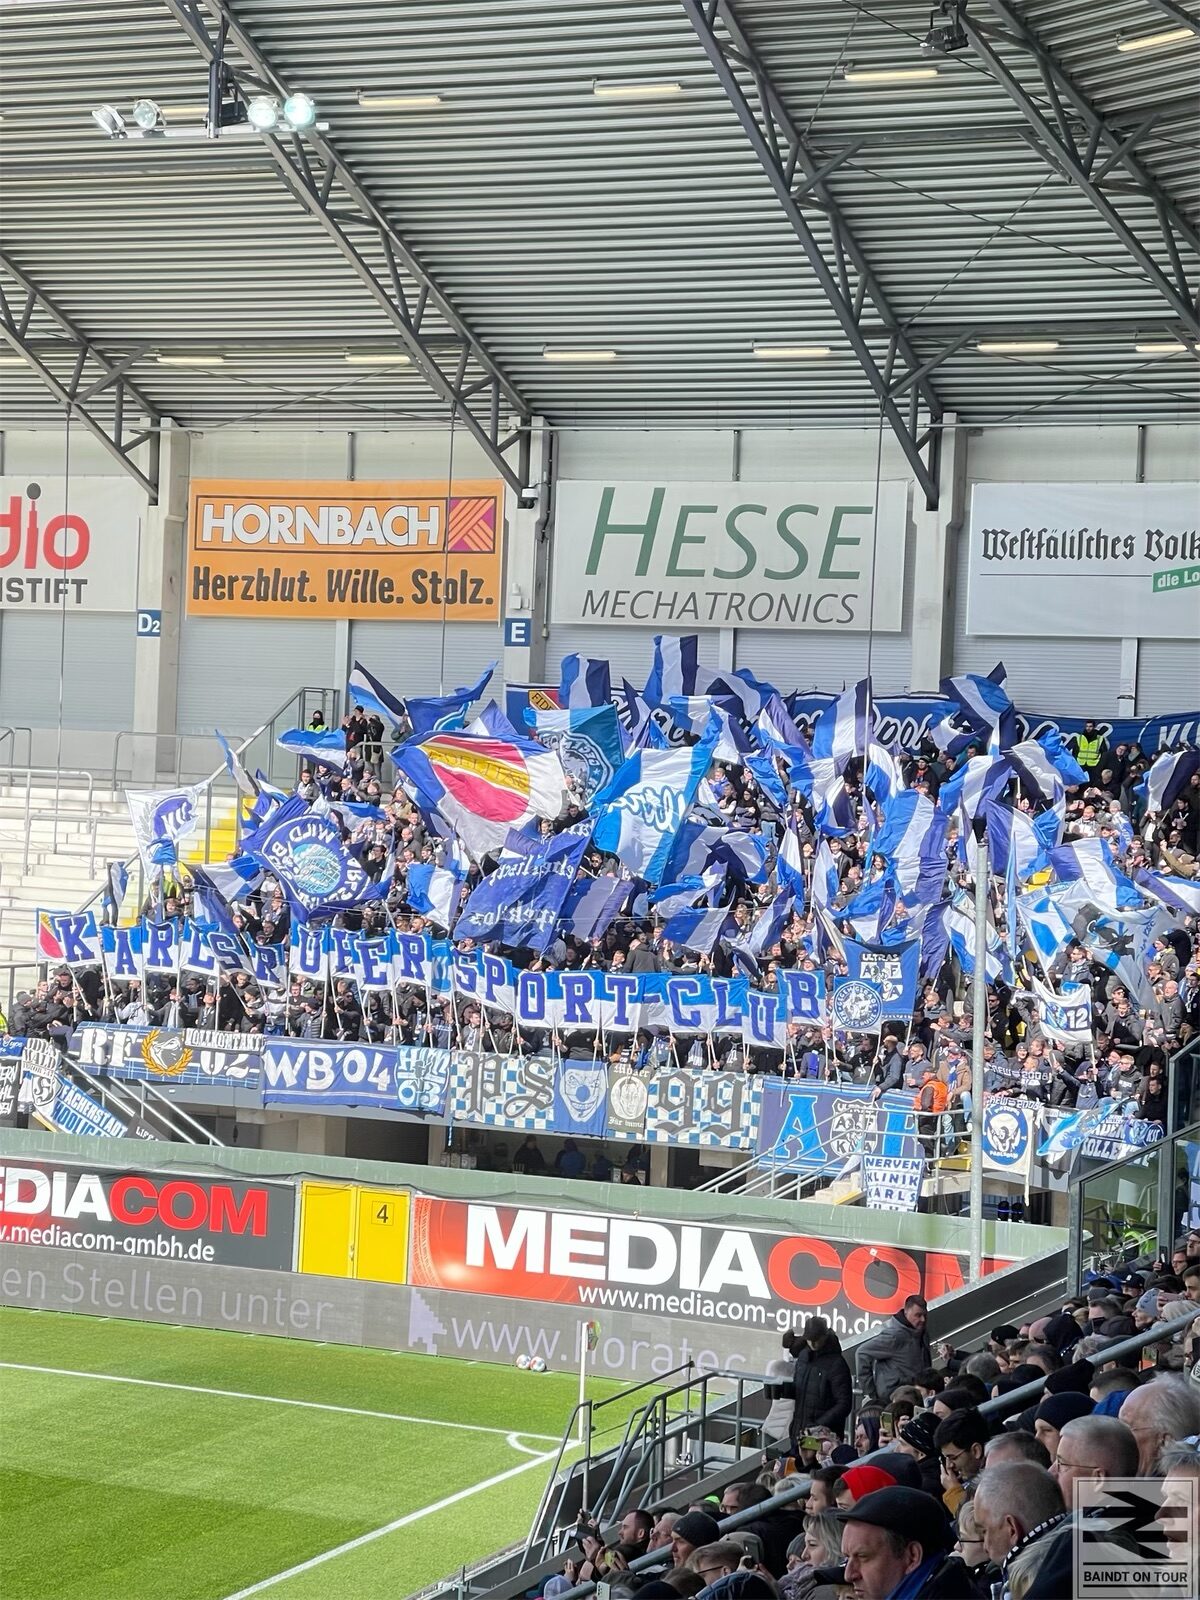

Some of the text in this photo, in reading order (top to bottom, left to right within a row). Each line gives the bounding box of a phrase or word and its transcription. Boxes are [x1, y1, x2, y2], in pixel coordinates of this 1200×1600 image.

[202, 503, 439, 546] HORNBACH
[585, 487, 873, 580] HESSE
[0, 577, 88, 604] STIFT
[193, 566, 494, 604] Herzblut. Wille. Stolz.
[1157, 573, 1180, 588] die
[582, 590, 858, 624] MECHATRONICS
[138, 613, 160, 633] D2
[511, 622, 526, 643] E
[59, 913, 426, 987] KARLSRUHER
[1066, 1008, 1088, 1028] 12
[60, 1082, 129, 1138] FÄCHERSTADT
[865, 1157, 921, 1170] NERVEN
[867, 1172, 919, 1187] KLINIK
[376, 1204, 389, 1224] 4
[62, 1262, 202, 1316] Stellen
[220, 1287, 335, 1331] unter
